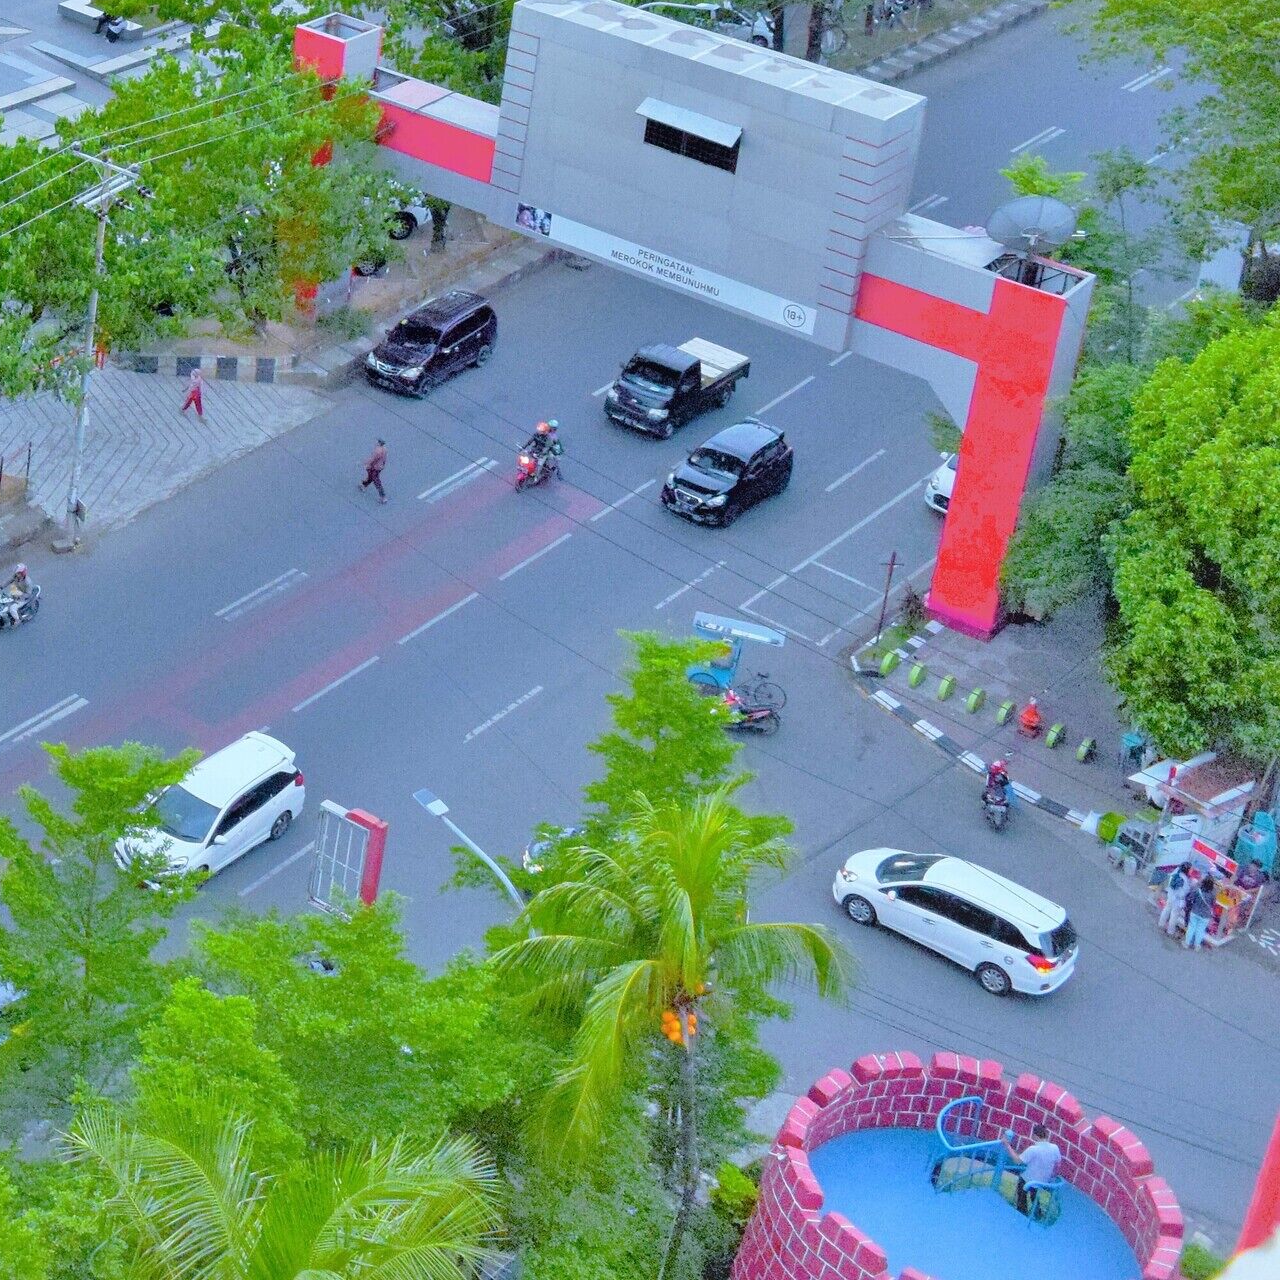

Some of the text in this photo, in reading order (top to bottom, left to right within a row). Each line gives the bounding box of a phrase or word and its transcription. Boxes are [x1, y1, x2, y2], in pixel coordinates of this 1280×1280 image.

[611, 250, 720, 296] MEROKOK MEMBUNUHMU
[638, 249, 695, 276] PERINGATAN:
[787, 309, 803, 320] 18+
